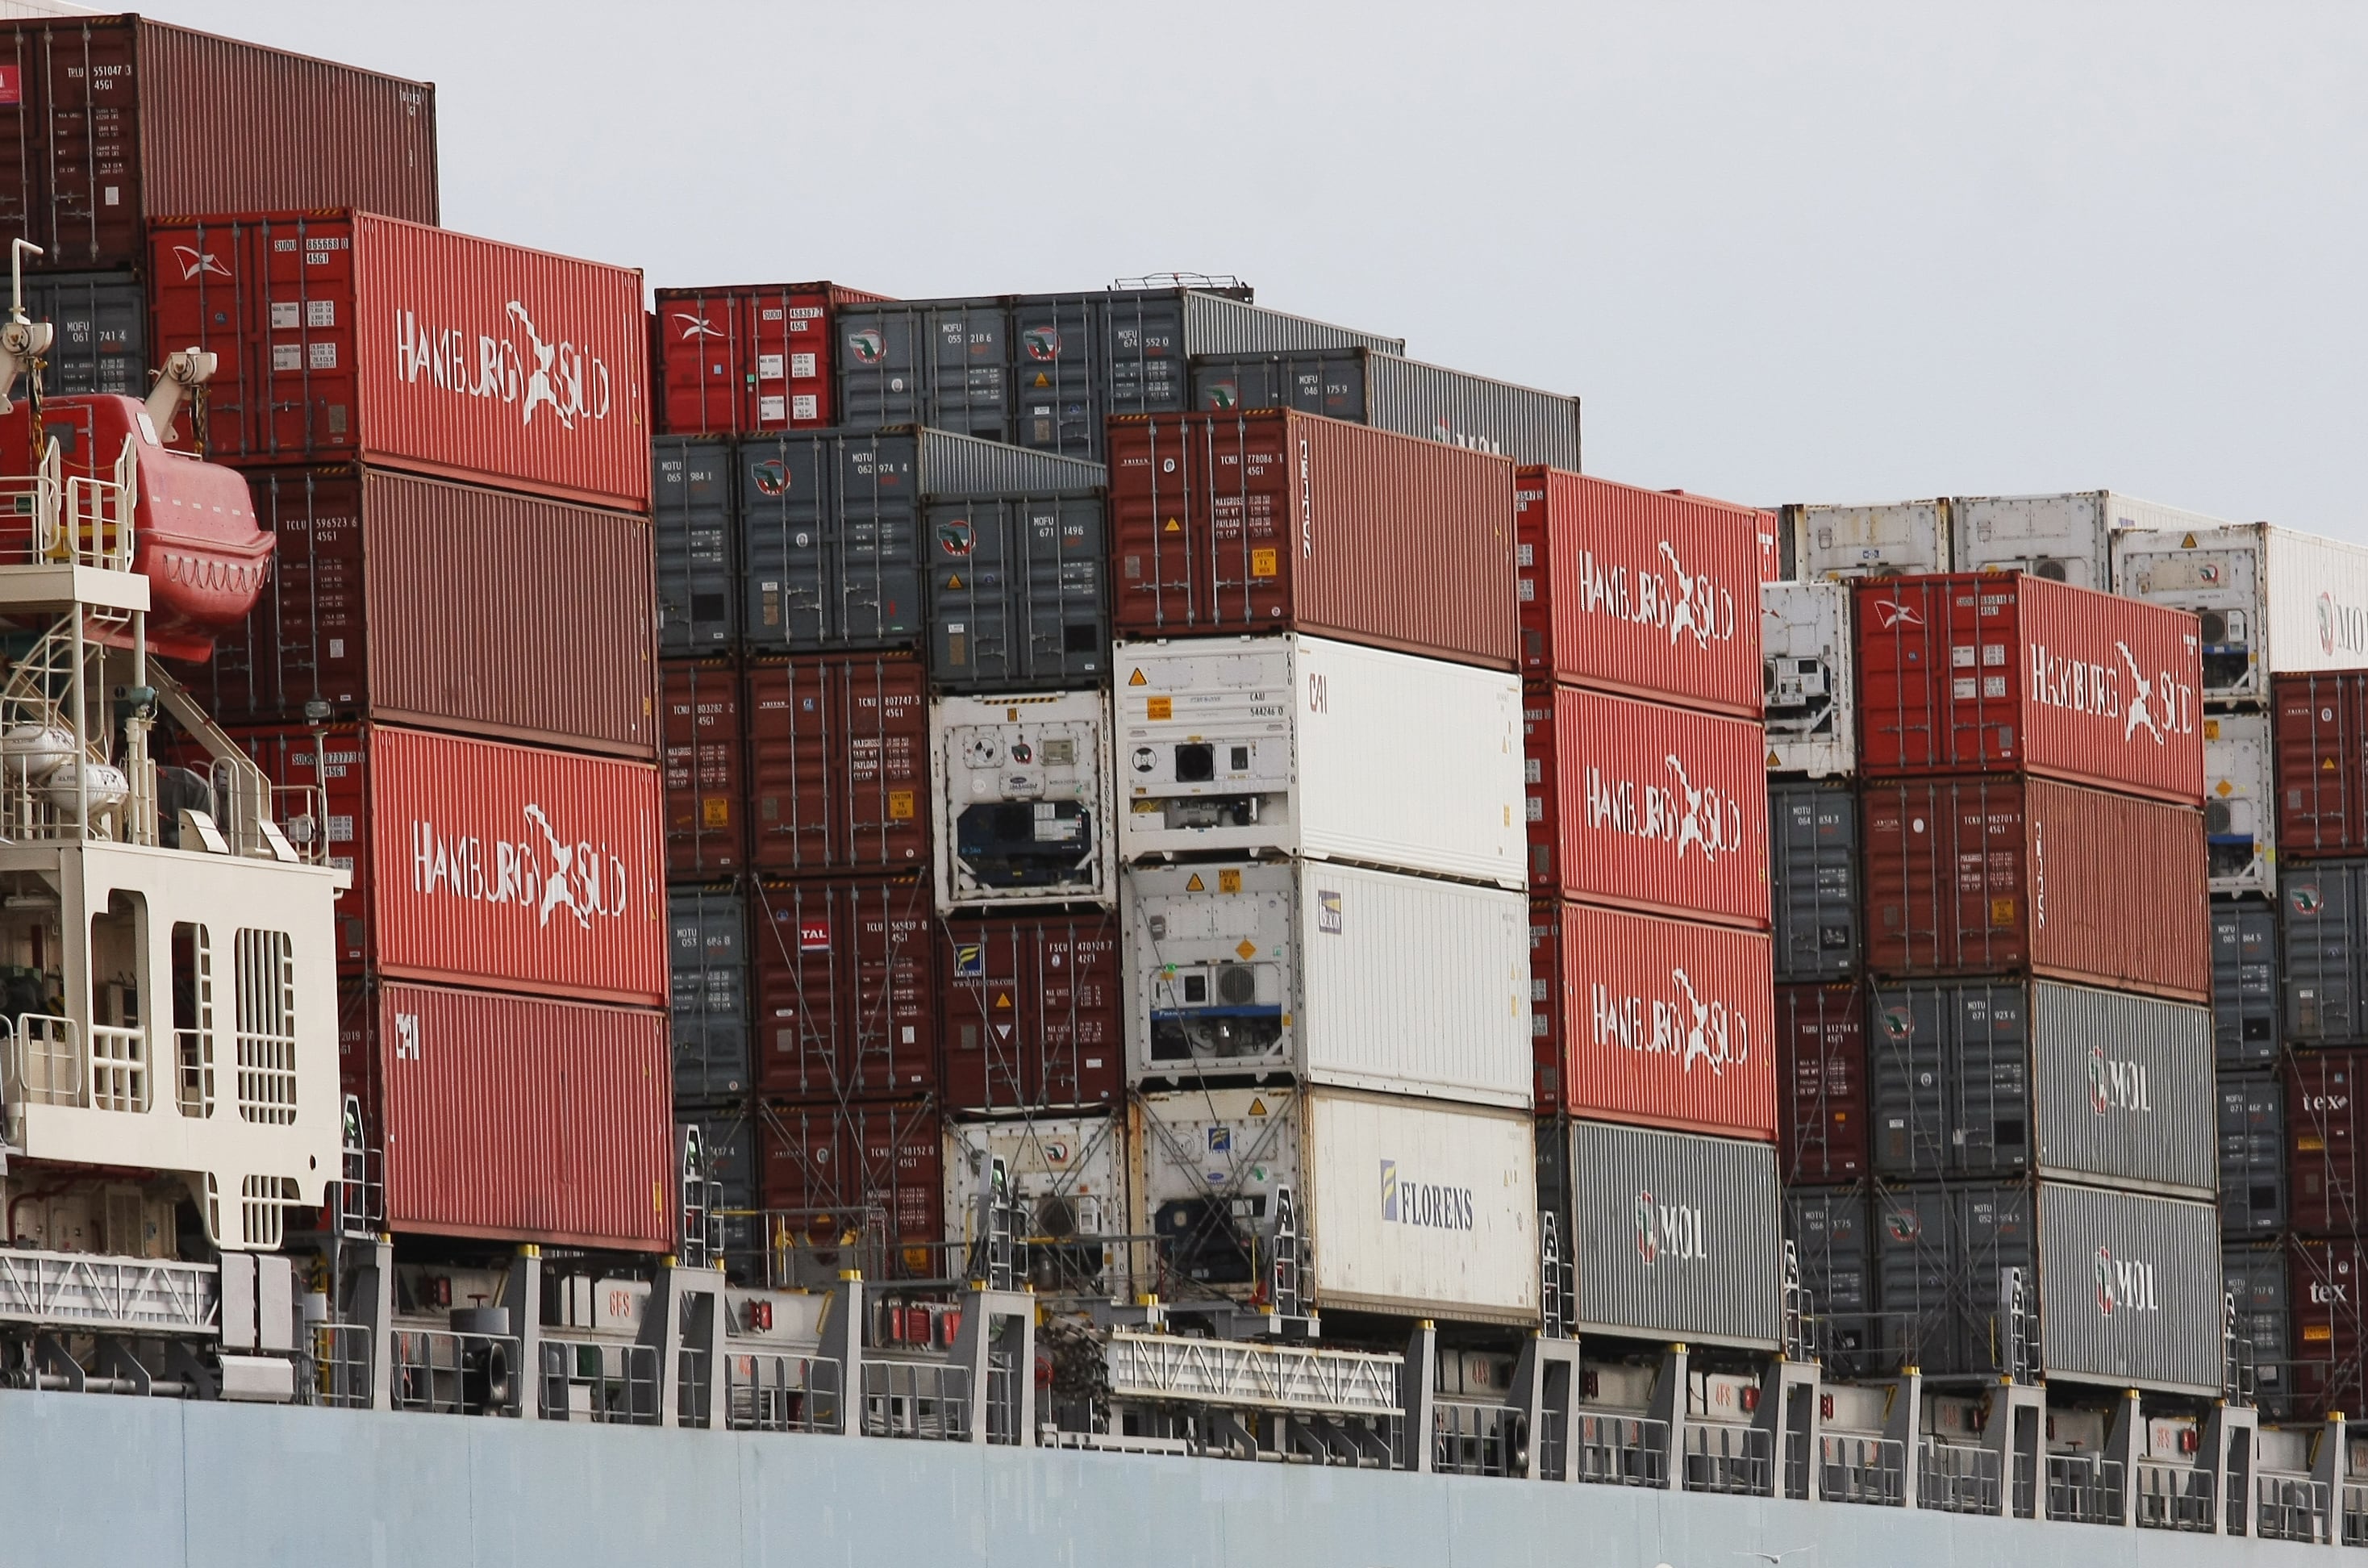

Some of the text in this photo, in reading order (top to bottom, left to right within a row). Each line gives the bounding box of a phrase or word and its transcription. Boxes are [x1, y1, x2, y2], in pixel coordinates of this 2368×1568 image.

[68, 65, 131, 77] TRLU 551047 3
[94, 80, 113, 90] 45G1
[275, 238, 348, 251] SUDU 865668 0
[307, 253, 328, 264] 45G1
[763, 311, 782, 319] SUDU
[67, 321, 127, 342] MOFU 061 741 4
[943, 324, 992, 344] MOFU 055 218 6
[1118, 331, 1169, 348] MOFU 674 552 0
[397, 309, 517, 403] HAMBURG
[1299, 375, 1347, 395] MOFU 046 175 9
[661, 461, 682, 471] MOTU
[853, 453, 907, 474] MOTU 062 974 4
[667, 473, 681, 482] 065
[690, 472, 704, 481] 984
[1247, 467, 1264, 476] 45G1
[286, 520, 306, 531] TCLU
[316, 518, 348, 529] 596523
[1034, 516, 1054, 526] MOFU
[1215, 518, 1240, 528] PAYLOAD
[317, 532, 337, 541] 45G1
[1039, 528, 1054, 537] 671
[1579, 549, 1667, 628] HAMBURG
[2030, 643, 2118, 718] HAMBURG
[858, 694, 920, 707] TCNU 807747 3
[1249, 692, 1265, 702] CAIU
[1309, 673, 1328, 715] CAI
[886, 709, 903, 718] 45G1
[1250, 707, 1283, 717] 544246 0
[698, 717, 715, 725] 45G1
[853, 760, 878, 769] PAYLOAD
[1586, 765, 1673, 843] HAMBURG
[413, 820, 534, 907] HAMBURG
[677, 929, 697, 938] MOTU
[866, 922, 883, 932] TCLU
[801, 929, 827, 939] TAL
[682, 939, 697, 947] 053
[1592, 982, 1680, 1057] HAMBURG
[395, 1013, 419, 1061] CAI
[2109, 1061, 2151, 1111] MOL
[2303, 1094, 2339, 1111] tex
[1401, 1182, 1473, 1231] FLORENS
[1659, 1205, 1707, 1260] MOL
[2116, 1260, 2158, 1310] MOL
[2310, 1281, 2347, 1303] tex
